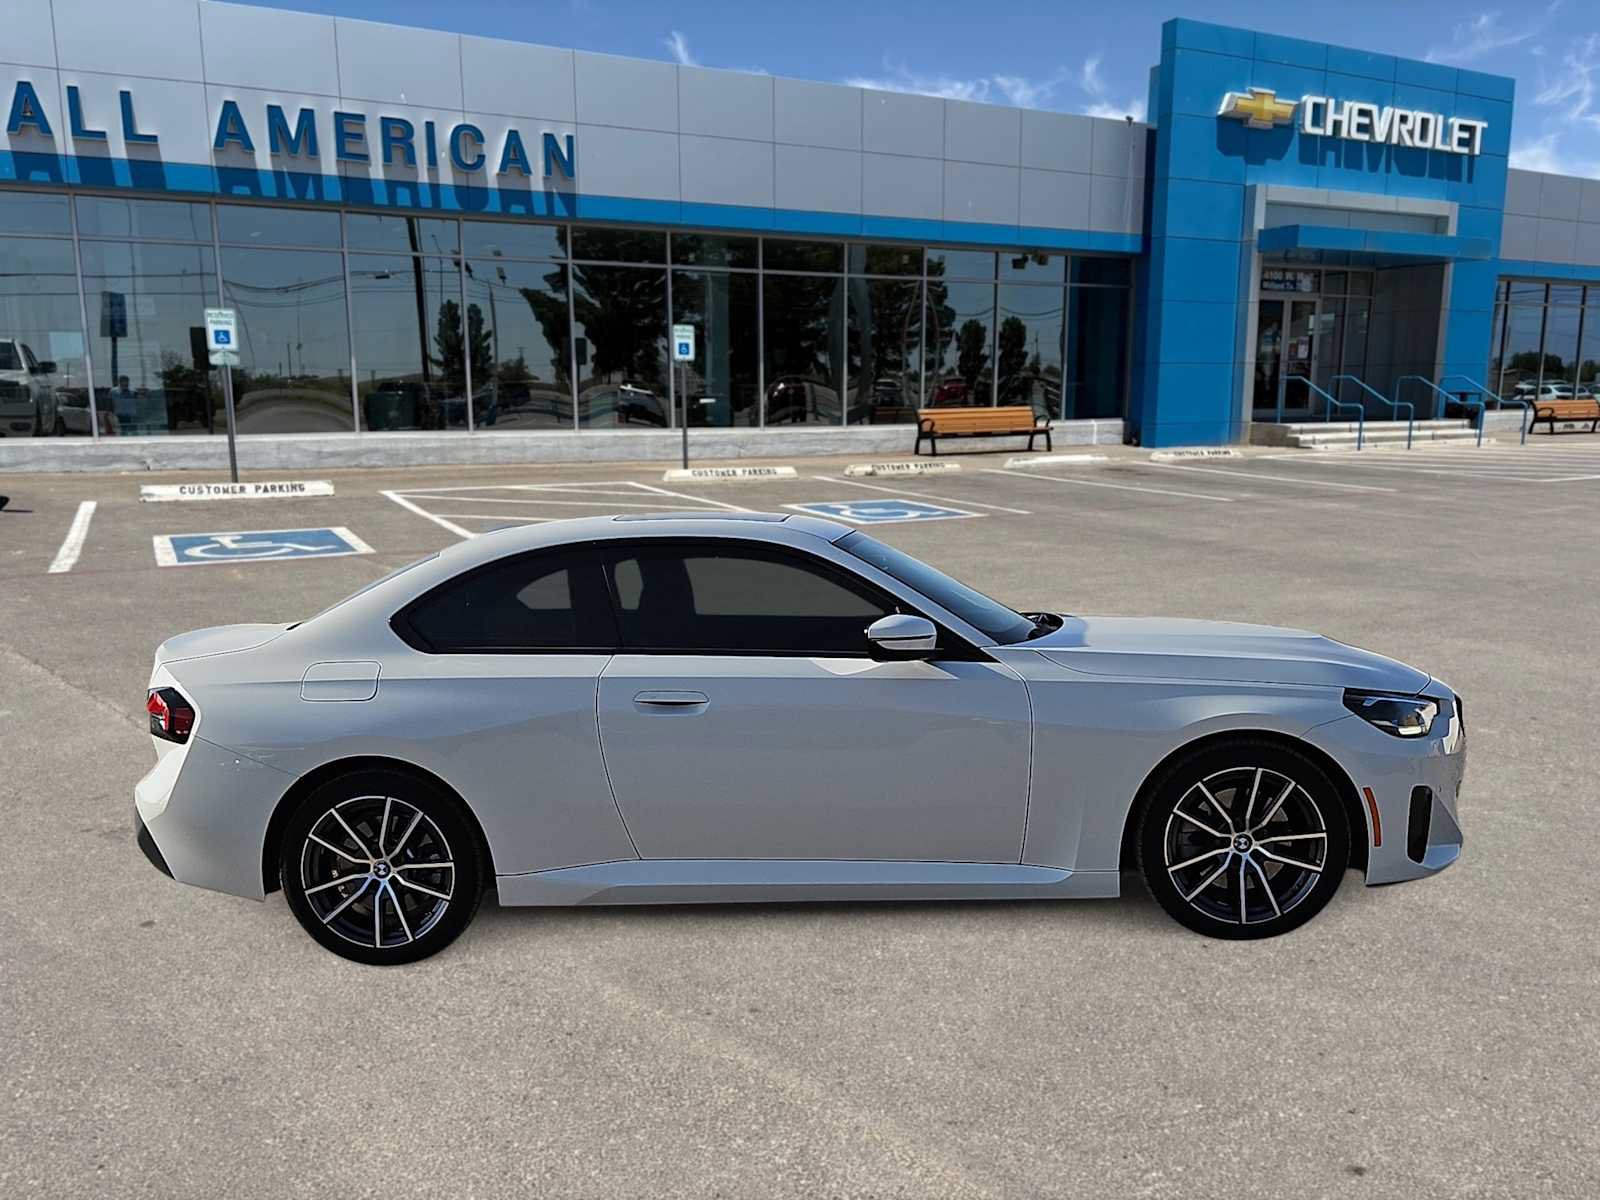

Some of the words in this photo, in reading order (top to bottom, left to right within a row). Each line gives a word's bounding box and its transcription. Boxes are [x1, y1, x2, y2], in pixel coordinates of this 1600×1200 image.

[6, 80, 159, 144] ALL
[213, 99, 577, 180] AMERICAN
[1301, 94, 1489, 155] CHEVROLET
[179, 485, 246, 495] CUSTOMER
[254, 483, 306, 493] PARKING
[691, 469, 737, 477] CUSTOMER
[741, 467, 778, 476] PARKING
